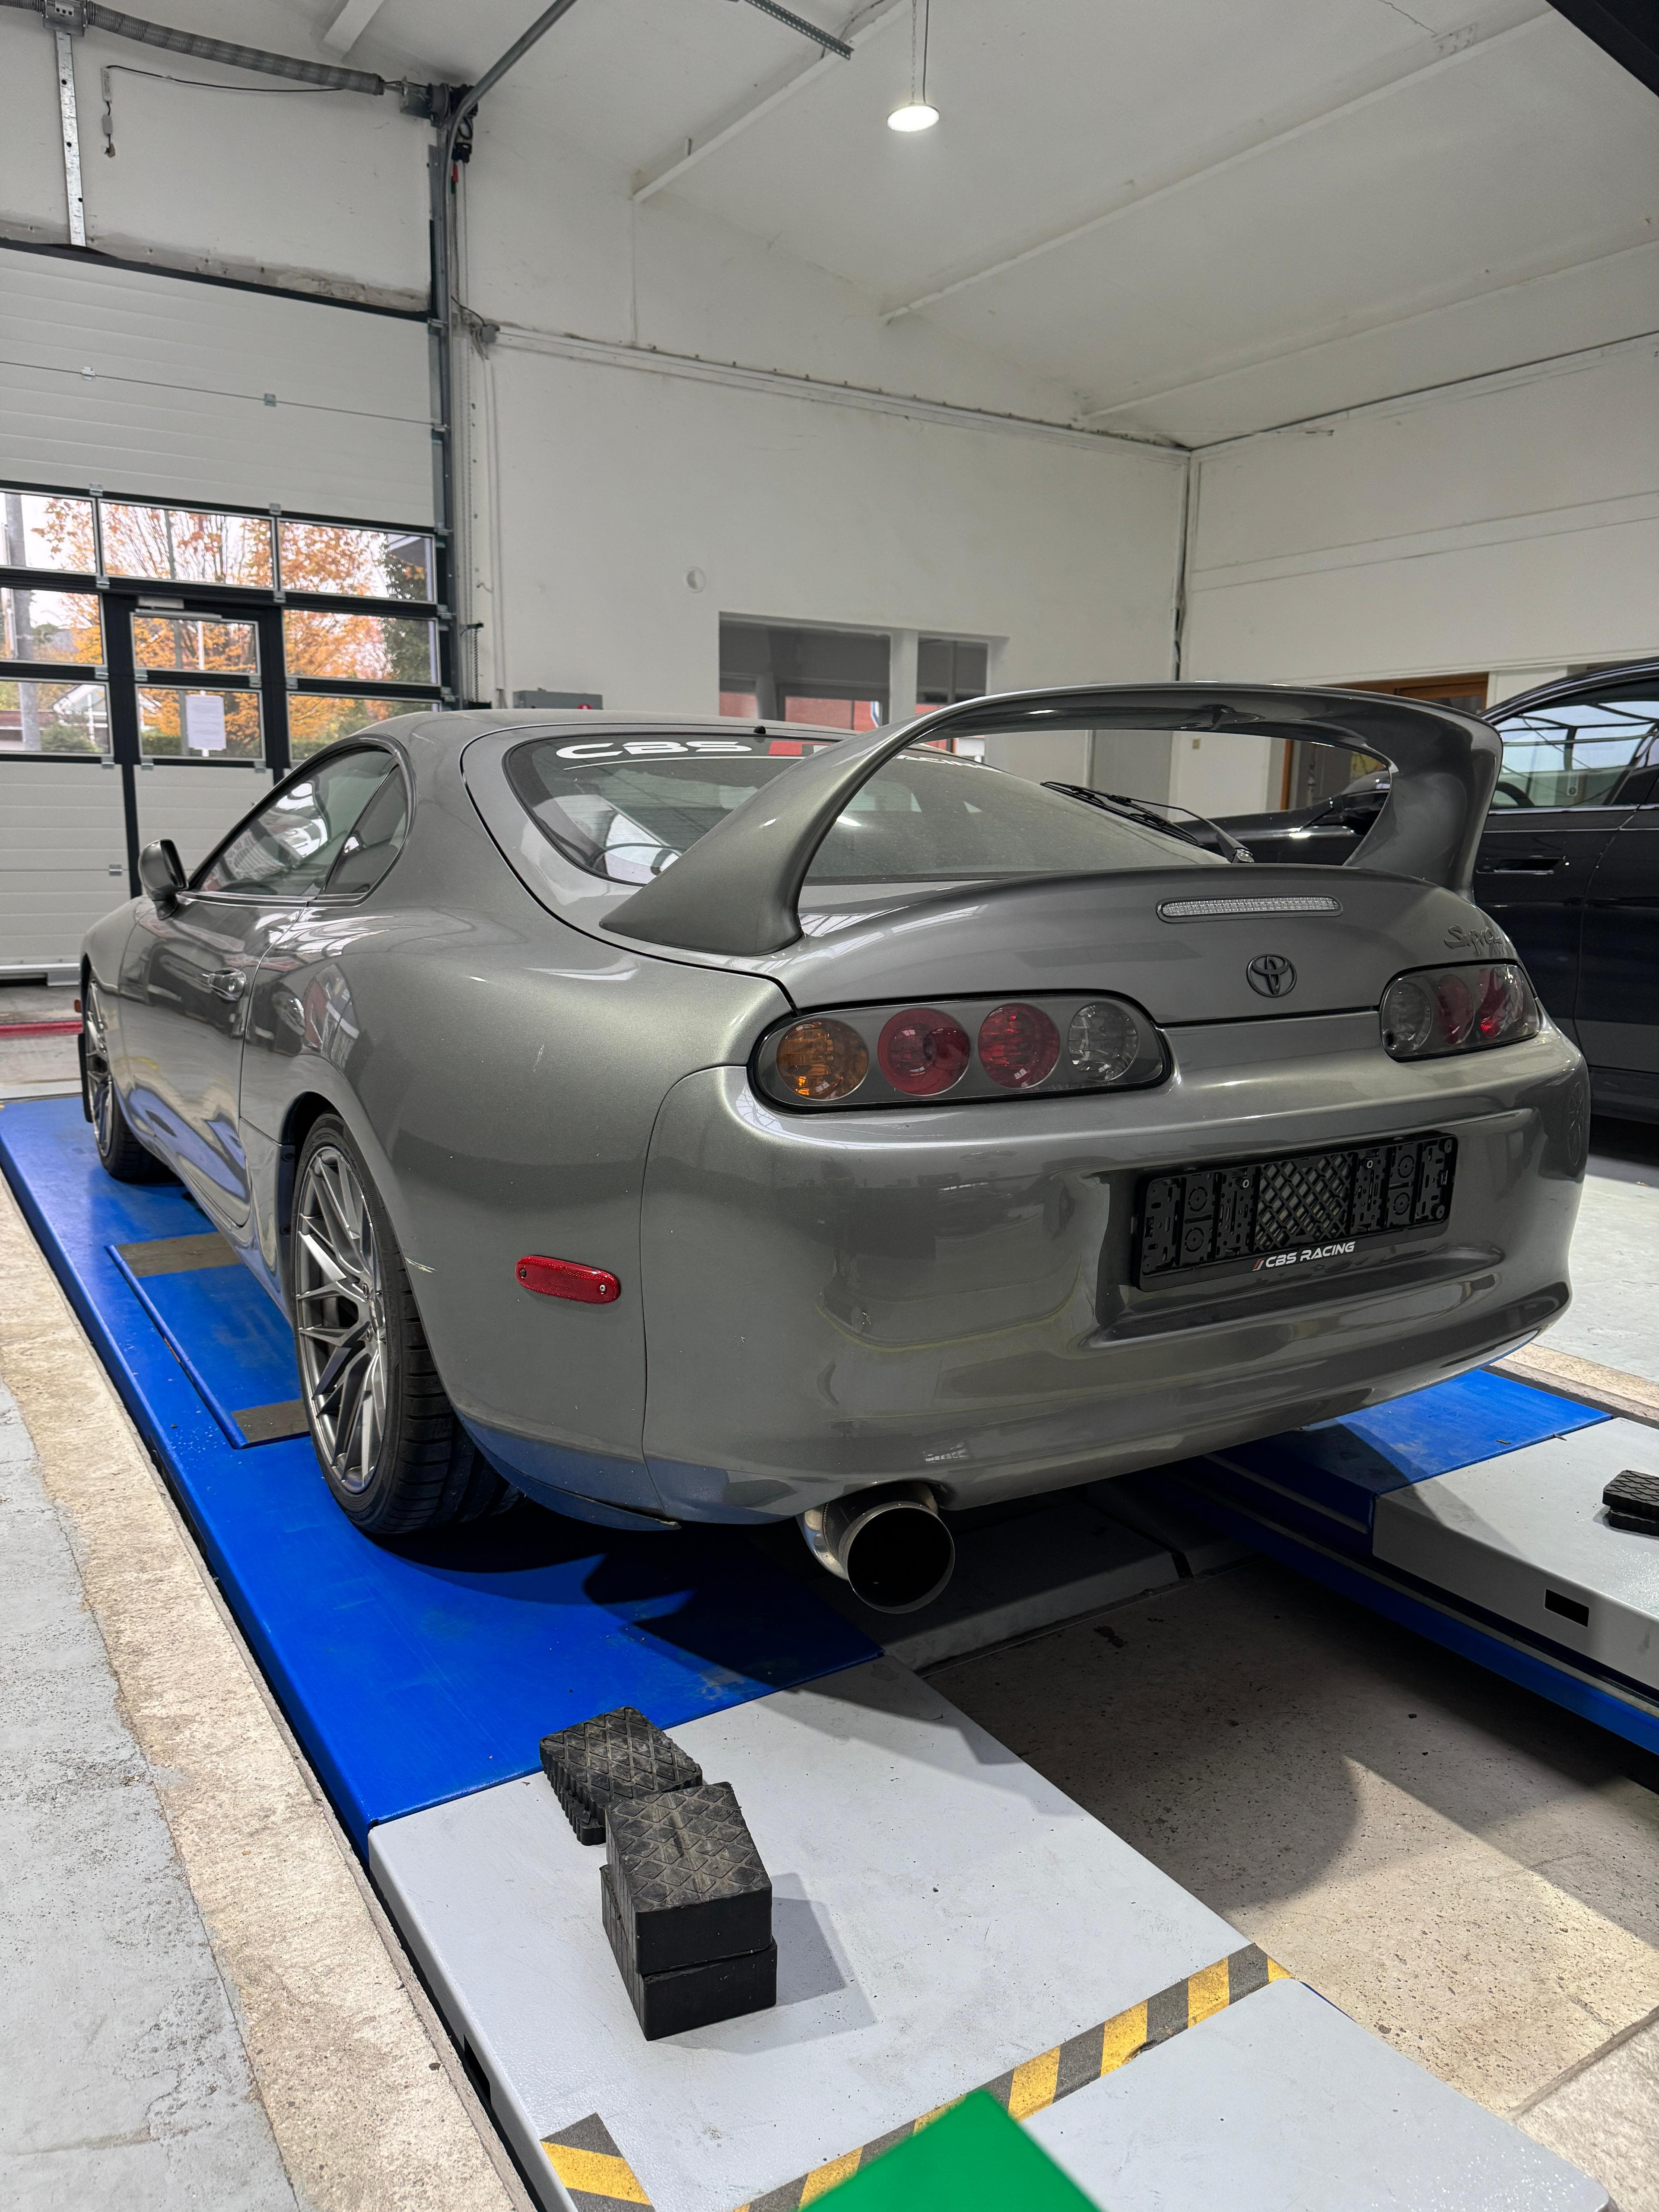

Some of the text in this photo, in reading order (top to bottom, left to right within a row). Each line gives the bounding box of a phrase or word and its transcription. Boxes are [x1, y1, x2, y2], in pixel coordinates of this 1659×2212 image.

[556, 741, 752, 759] CBS
[1265, 1241, 1356, 1268] CBS RACING
